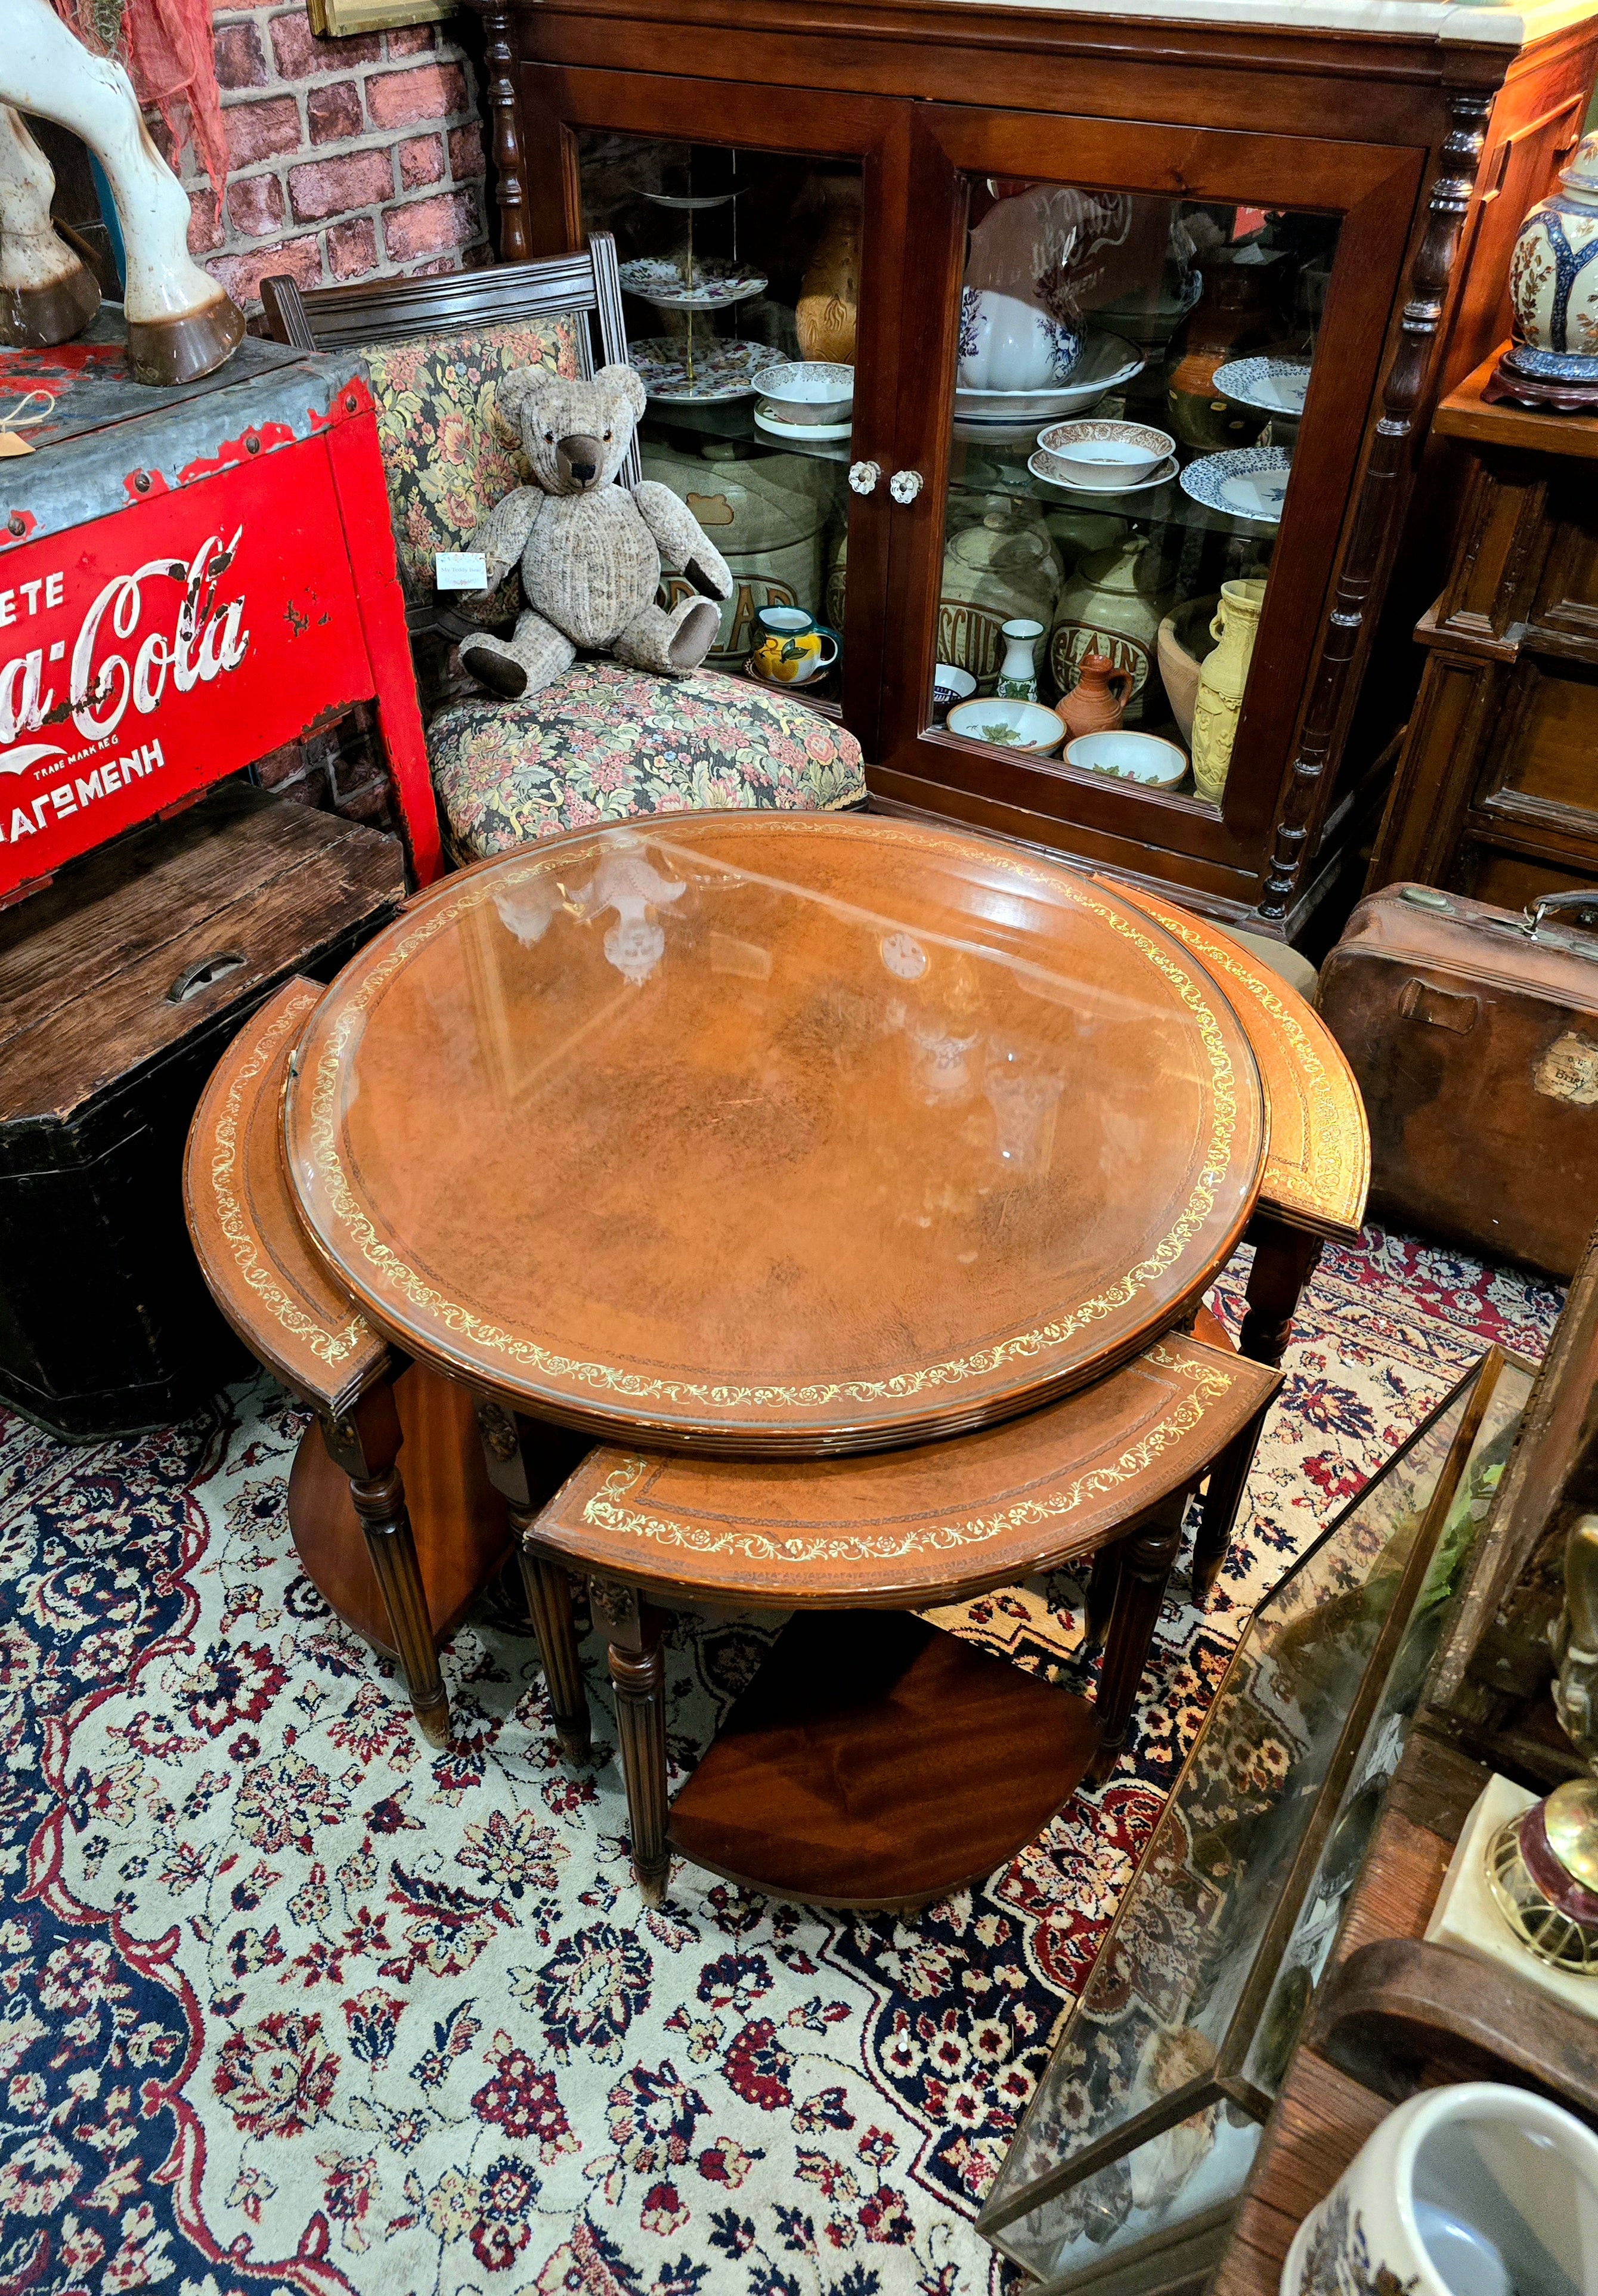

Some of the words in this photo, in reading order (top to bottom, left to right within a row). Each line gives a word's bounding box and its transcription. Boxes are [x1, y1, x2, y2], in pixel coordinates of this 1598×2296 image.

[0, 738, 165, 844] ΑΓΩΜΕΝΗ
[33, 759, 66, 781] TRADE
[67, 745, 97, 765] MARK
[98, 734, 119, 750] REG
